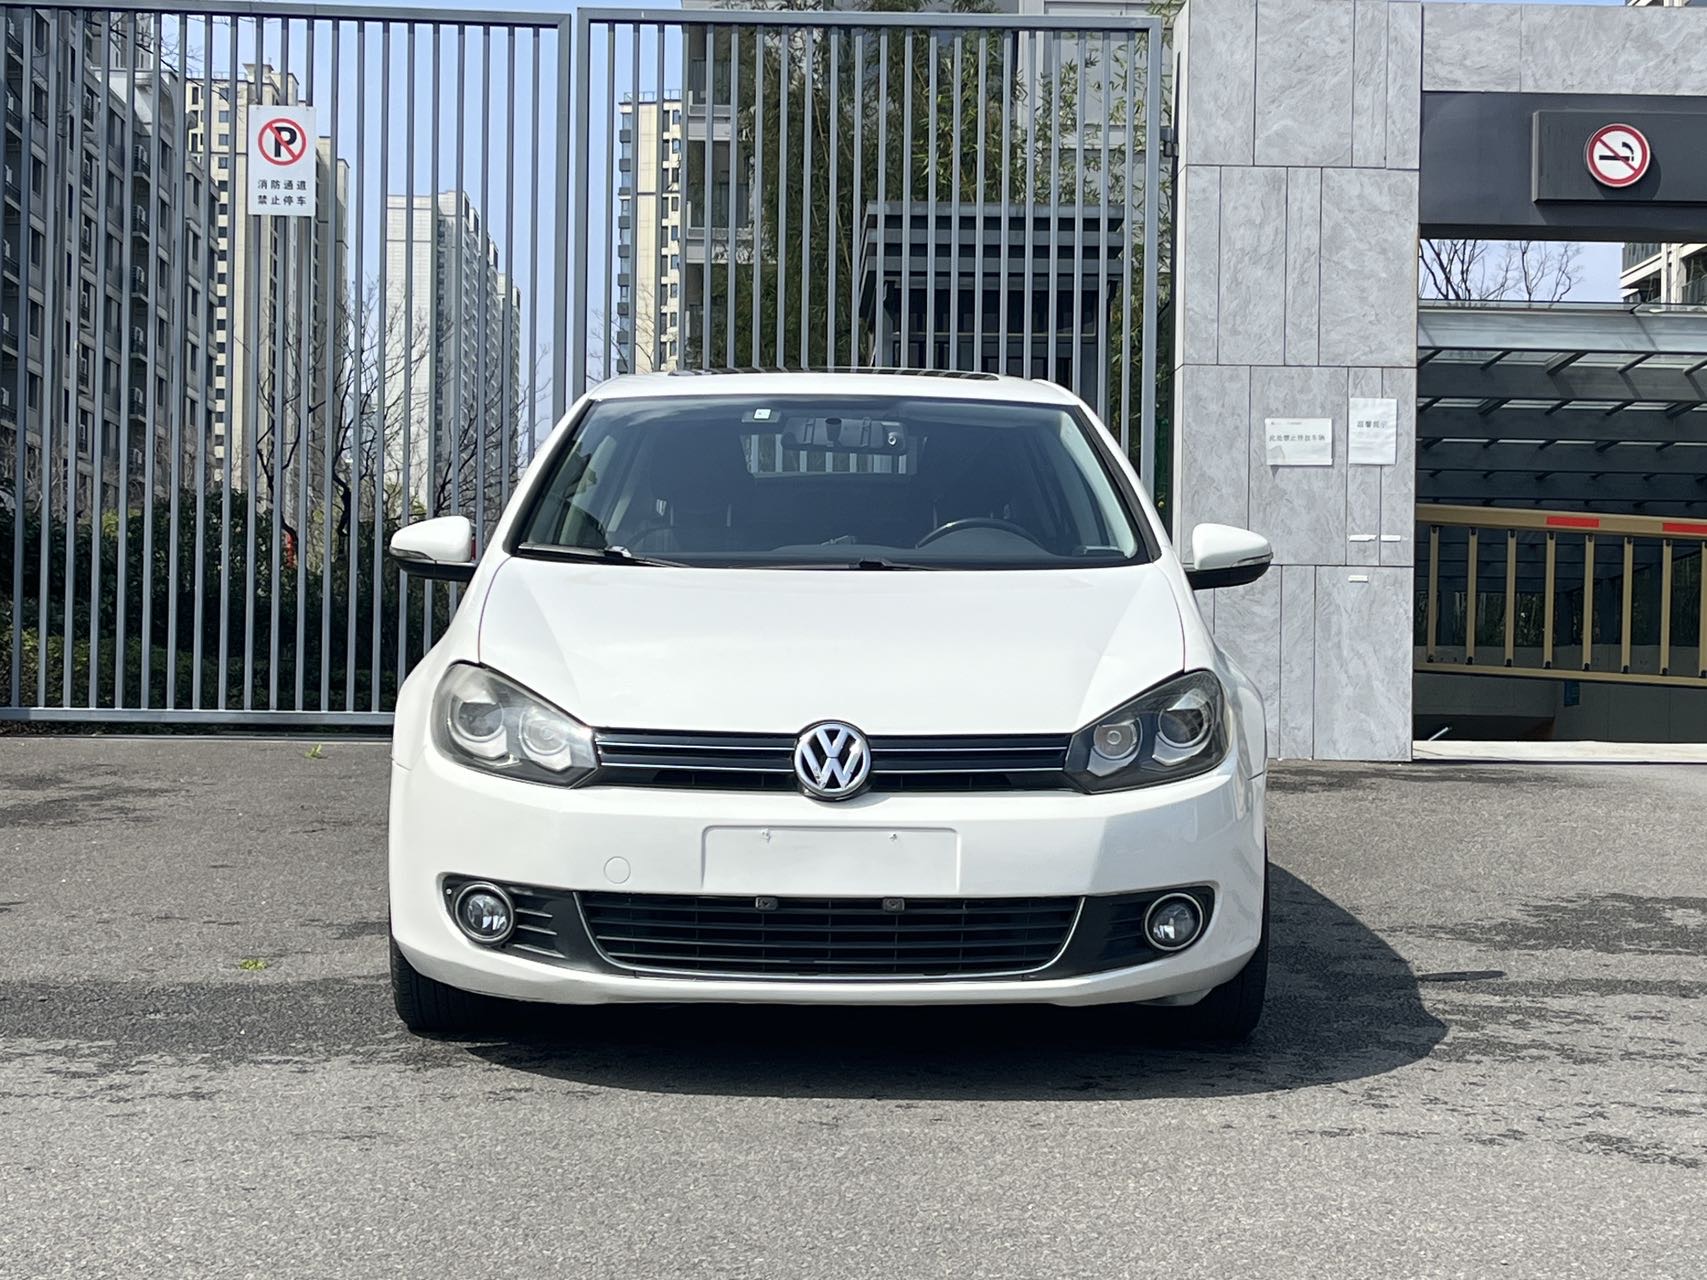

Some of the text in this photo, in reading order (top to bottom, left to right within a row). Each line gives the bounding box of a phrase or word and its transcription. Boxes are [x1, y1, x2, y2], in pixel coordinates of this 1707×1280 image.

[274, 126, 298, 158] P
[258, 179, 307, 191] 消防通道
[258, 195, 307, 206] 禁止停车
